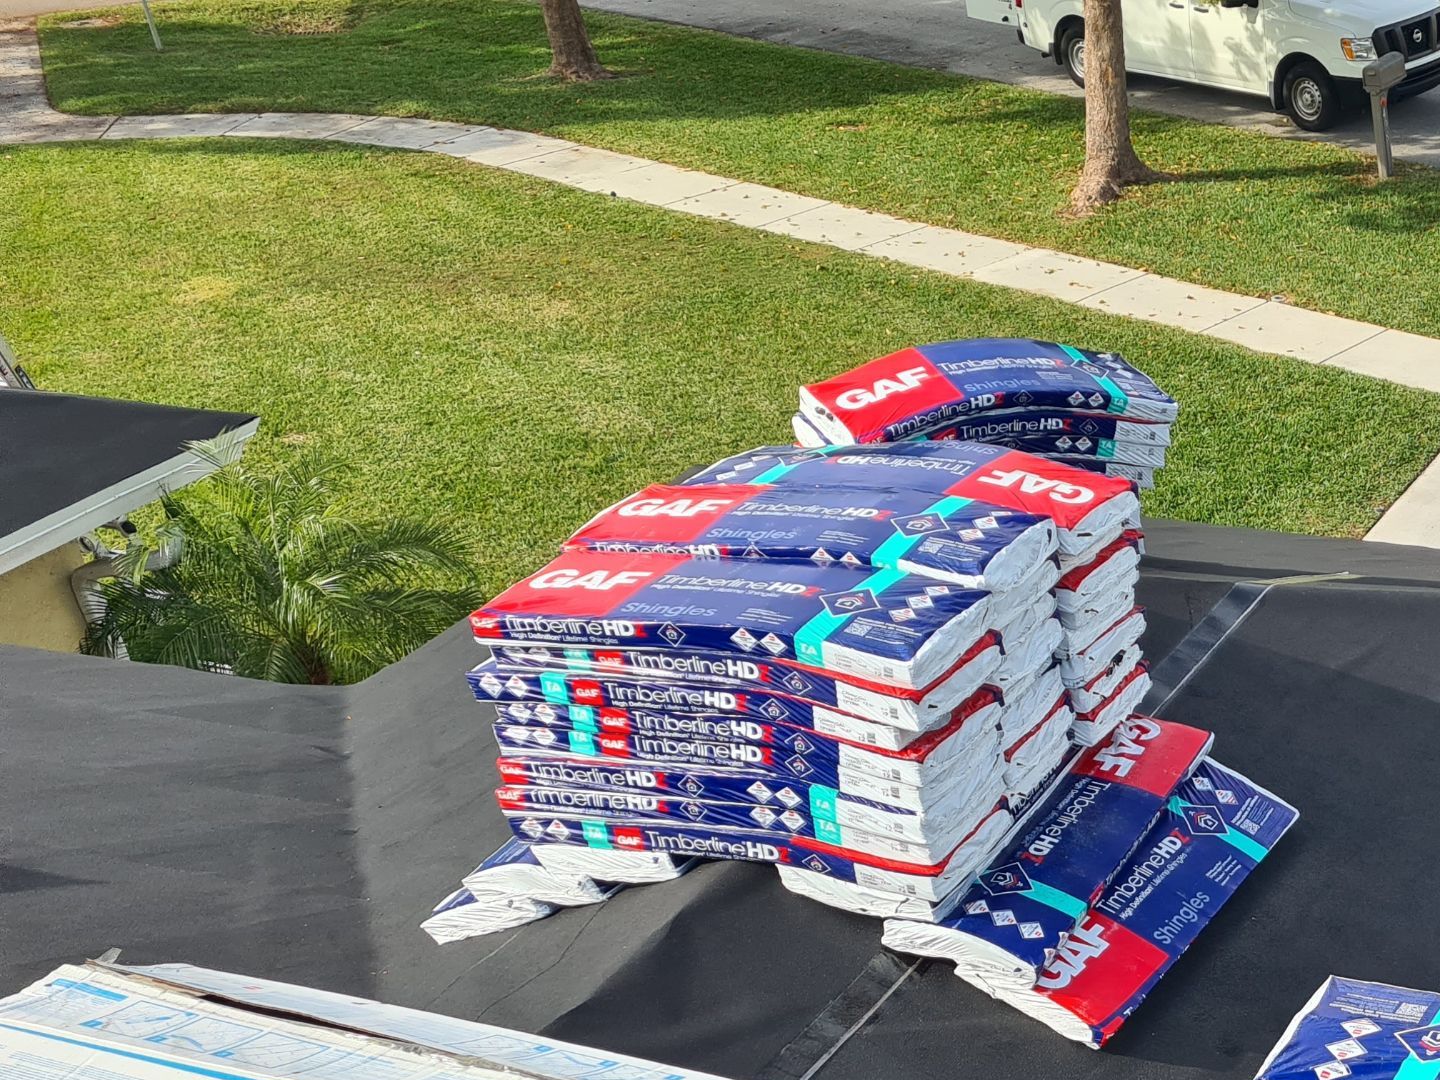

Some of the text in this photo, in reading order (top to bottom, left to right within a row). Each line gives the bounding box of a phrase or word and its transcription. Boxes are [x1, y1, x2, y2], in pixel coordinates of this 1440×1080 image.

[835, 366, 928, 409] GAF
[964, 378, 1040, 393] Shingles
[889, 401, 970, 435] Timberline
[961, 418, 1040, 440] Timberline
[978, 469, 1095, 504] GAF
[618, 498, 731, 517] GAF
[706, 528, 798, 542] Shingles
[529, 569, 653, 590] GAF
[658, 574, 767, 590] Timberline
[621, 602, 717, 617] Shingles
[627, 652, 726, 675] Timberline
[576, 688, 599, 698] GAF
[604, 682, 702, 705] Timberline
[631, 711, 731, 735] Timberline
[631, 735, 731, 757] Timberline
[1093, 718, 1161, 777] GAF
[530, 762, 626, 786] Timberline
[1045, 780, 1111, 837] Timberline
[617, 834, 640, 846] GAF
[645, 830, 747, 854] Timberline
[1096, 854, 1165, 914] Timberline
[1154, 891, 1210, 944] Shingles
[1037, 915, 1110, 989] GAF
